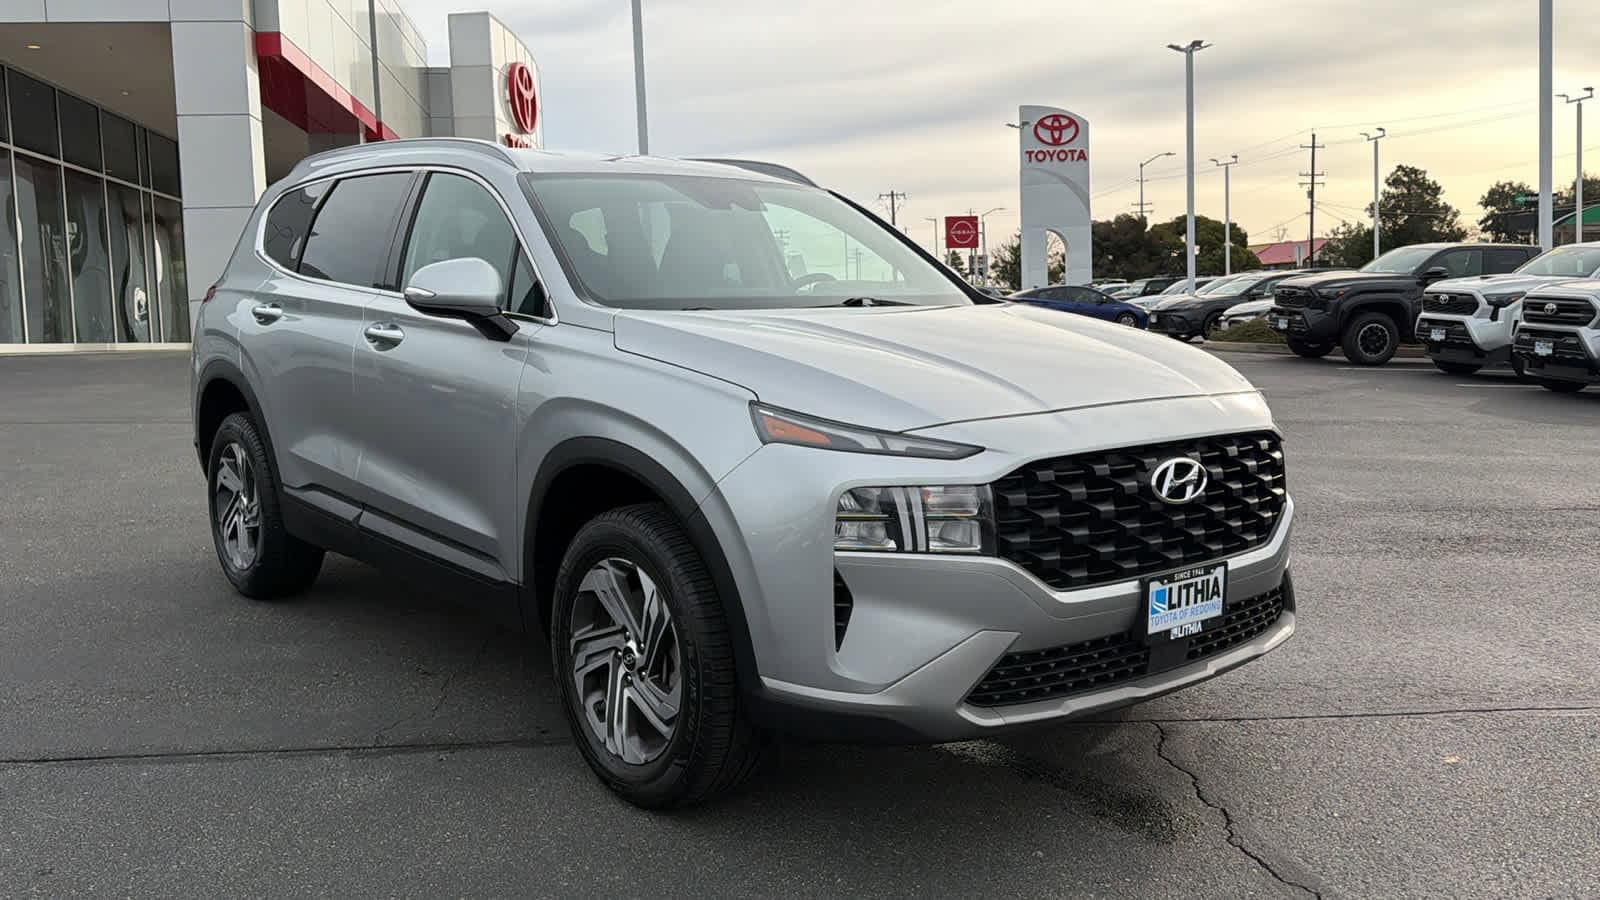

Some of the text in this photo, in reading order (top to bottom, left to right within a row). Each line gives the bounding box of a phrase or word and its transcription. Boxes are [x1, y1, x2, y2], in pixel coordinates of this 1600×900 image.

[1025, 149, 1087, 162] TOYOTA
[1174, 570, 1191, 581] SINCE
[1168, 576, 1220, 611] LITHIA
[1151, 599, 1221, 626] TOYOTA OF REDDING
[1176, 621, 1202, 638] LITHIA
